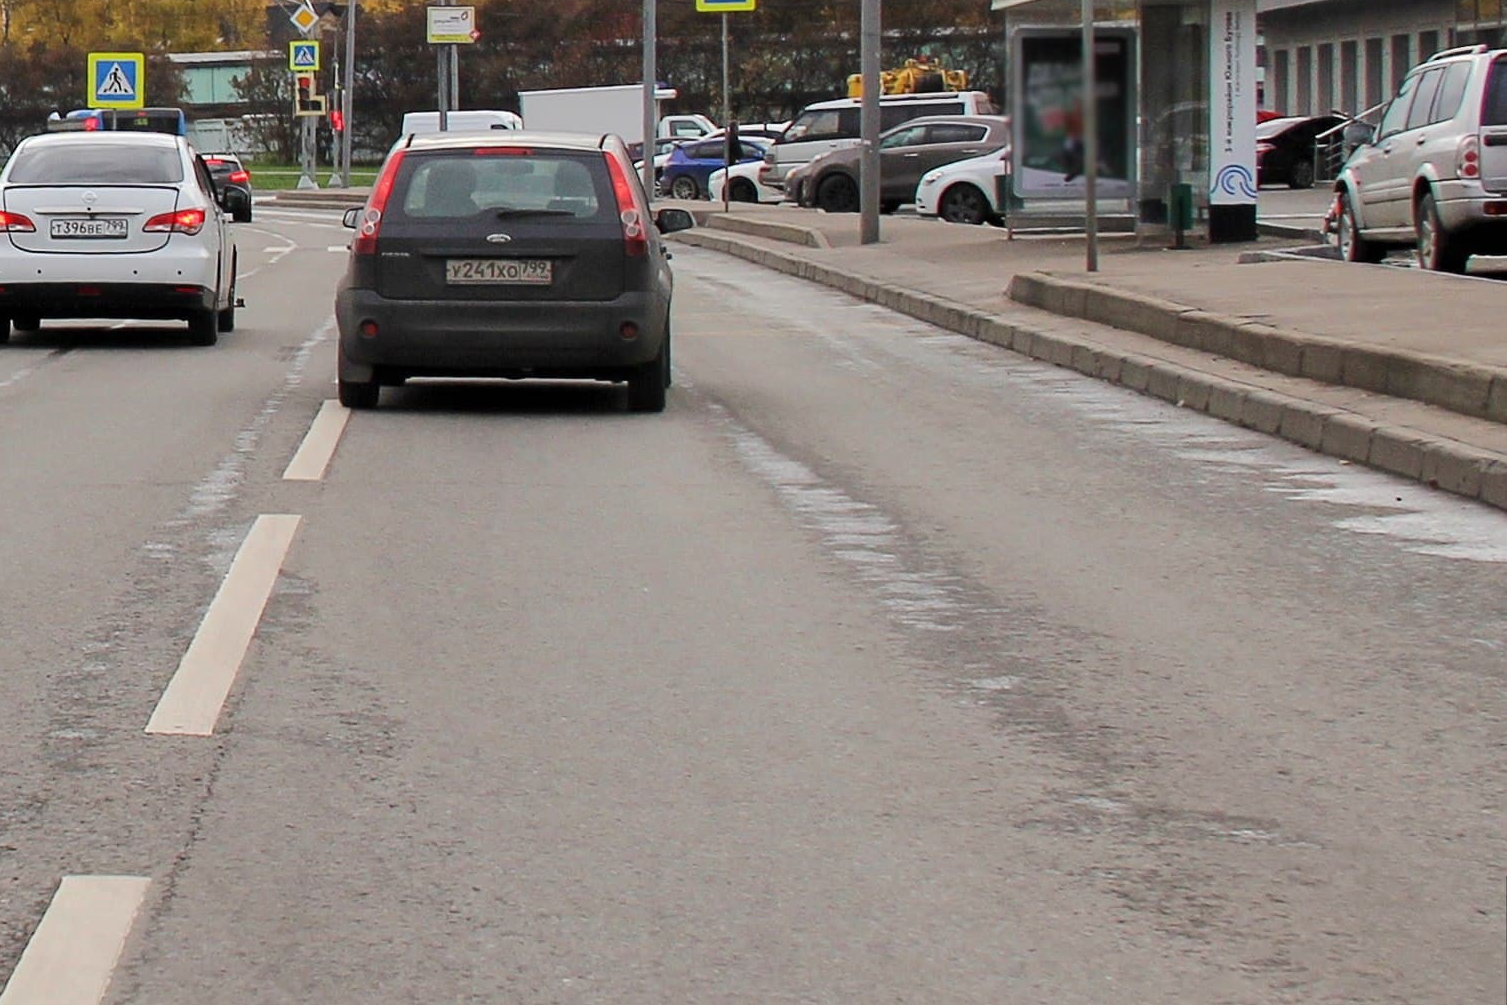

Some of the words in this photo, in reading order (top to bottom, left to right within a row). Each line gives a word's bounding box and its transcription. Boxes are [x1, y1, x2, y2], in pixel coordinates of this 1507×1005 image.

[55, 220, 103, 235] Т396ВЕ
[104, 219, 125, 231] 799
[451, 262, 519, 278] У241ХО
[521, 261, 547, 275] 799
